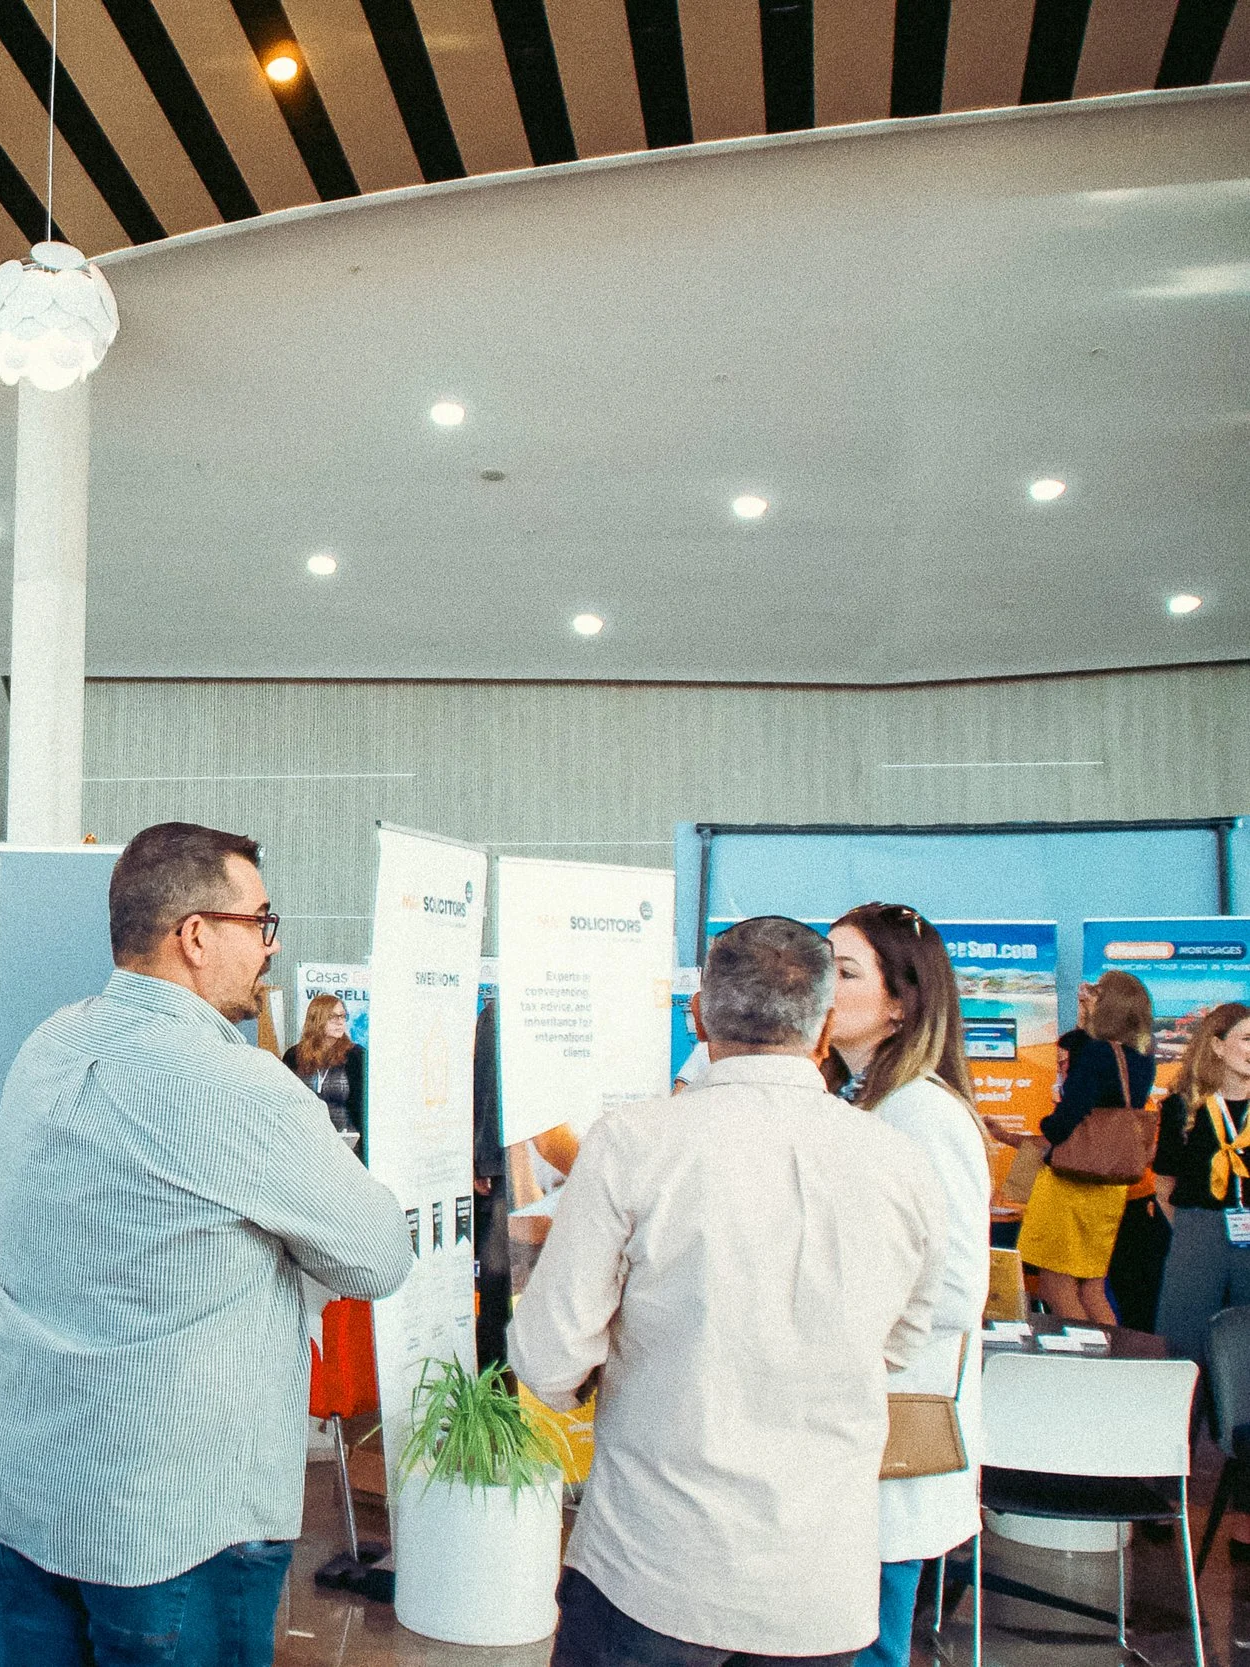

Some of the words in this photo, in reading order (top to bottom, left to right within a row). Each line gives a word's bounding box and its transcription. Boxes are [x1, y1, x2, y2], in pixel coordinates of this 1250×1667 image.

[423, 895, 468, 918] SOLICITORS
[569, 915, 642, 934] SOLICITORS
[1178, 945, 1243, 956] MORTGAGES
[305, 969, 349, 984] Casas
[334, 989, 370, 1002] SELL
